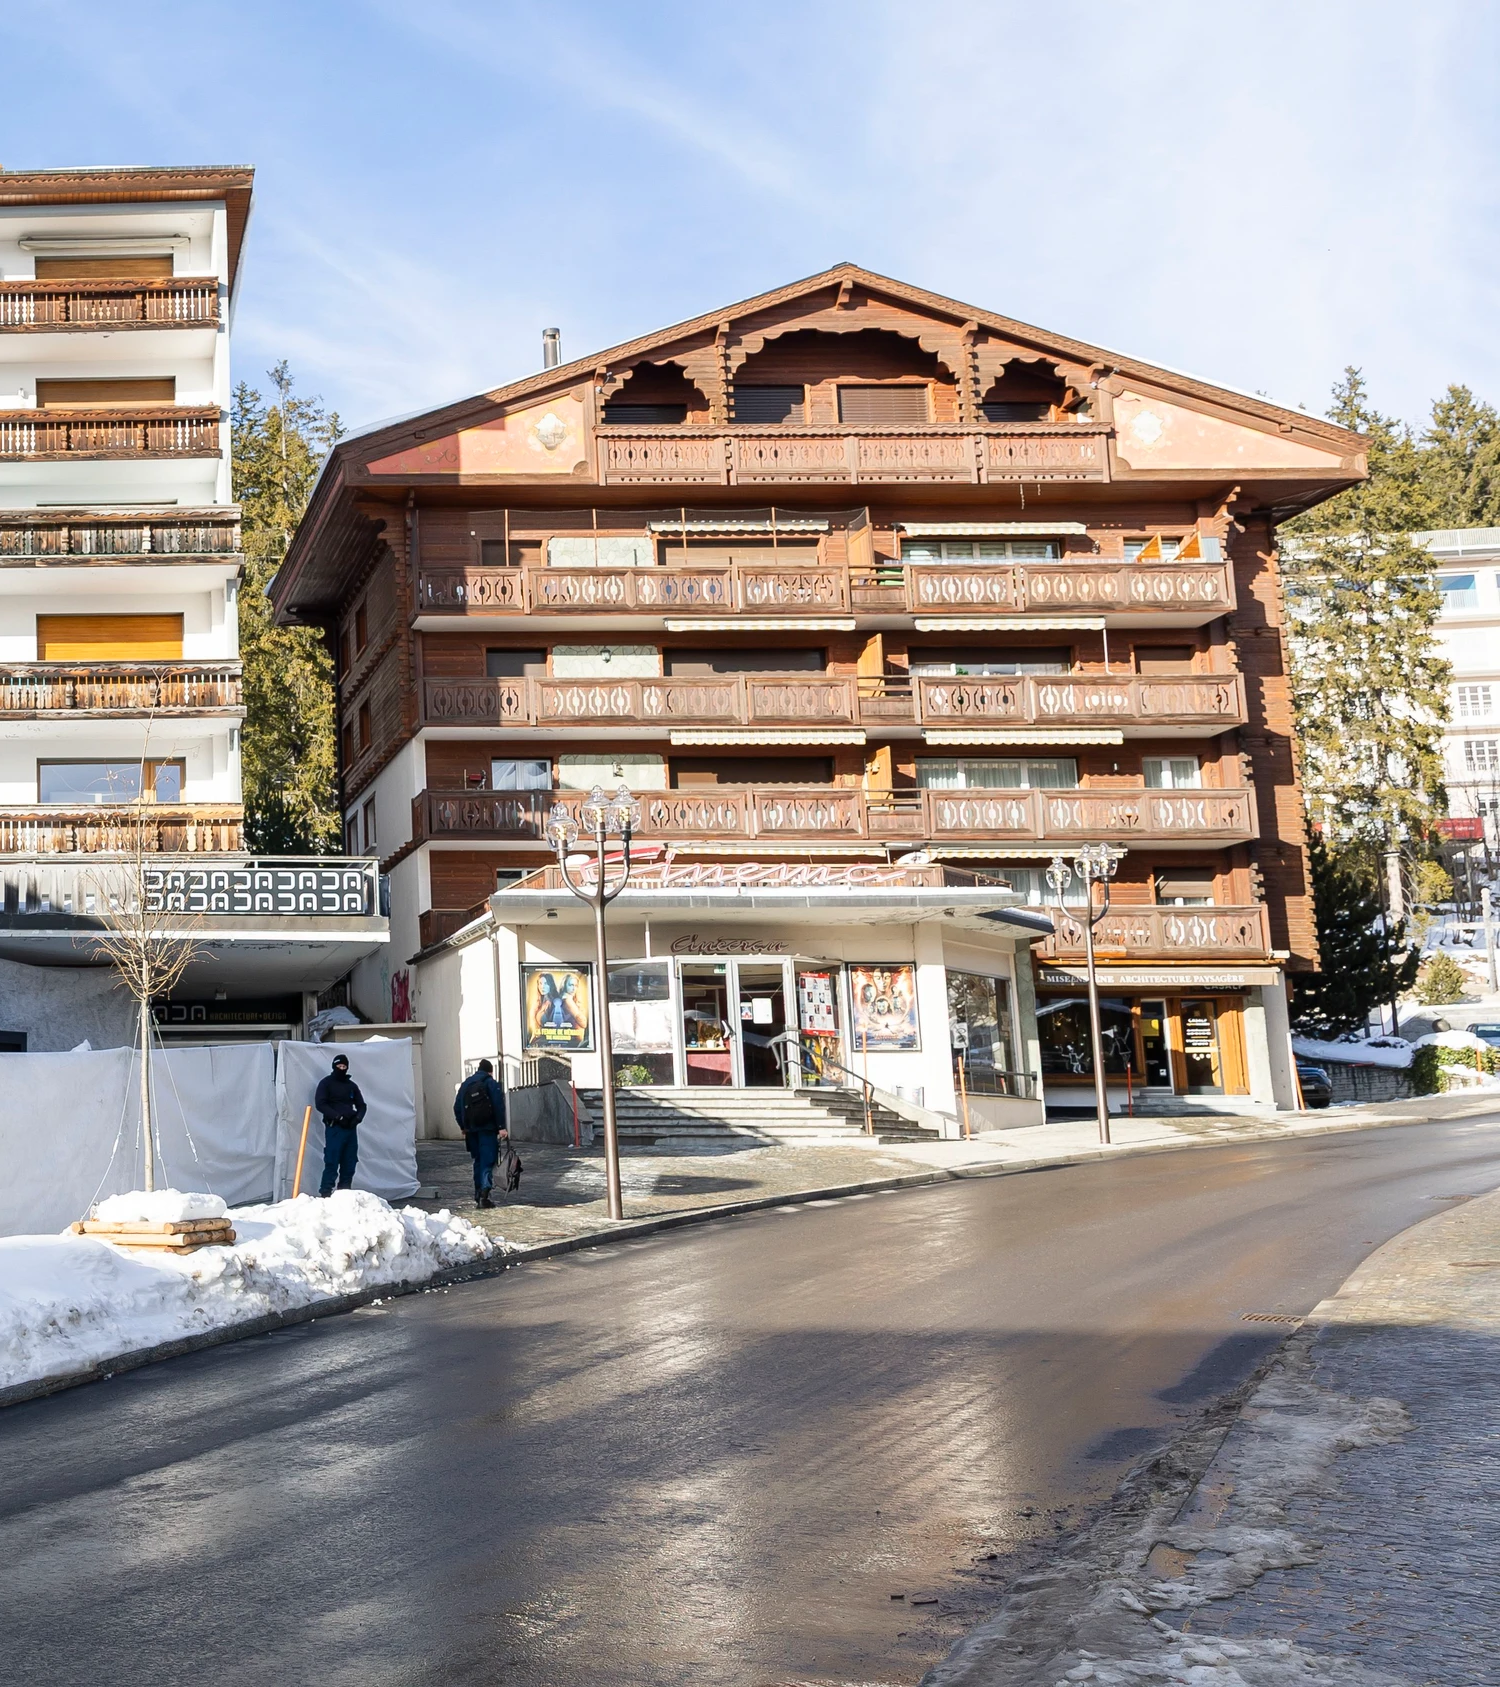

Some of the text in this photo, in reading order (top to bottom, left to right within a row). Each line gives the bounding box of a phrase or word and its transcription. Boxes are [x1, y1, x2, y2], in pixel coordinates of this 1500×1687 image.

[579, 846, 907, 883] Cinema
[1119, 975, 1193, 984] ARCHITECTURE
[1193, 973, 1245, 984] PAYSAGÈRE
